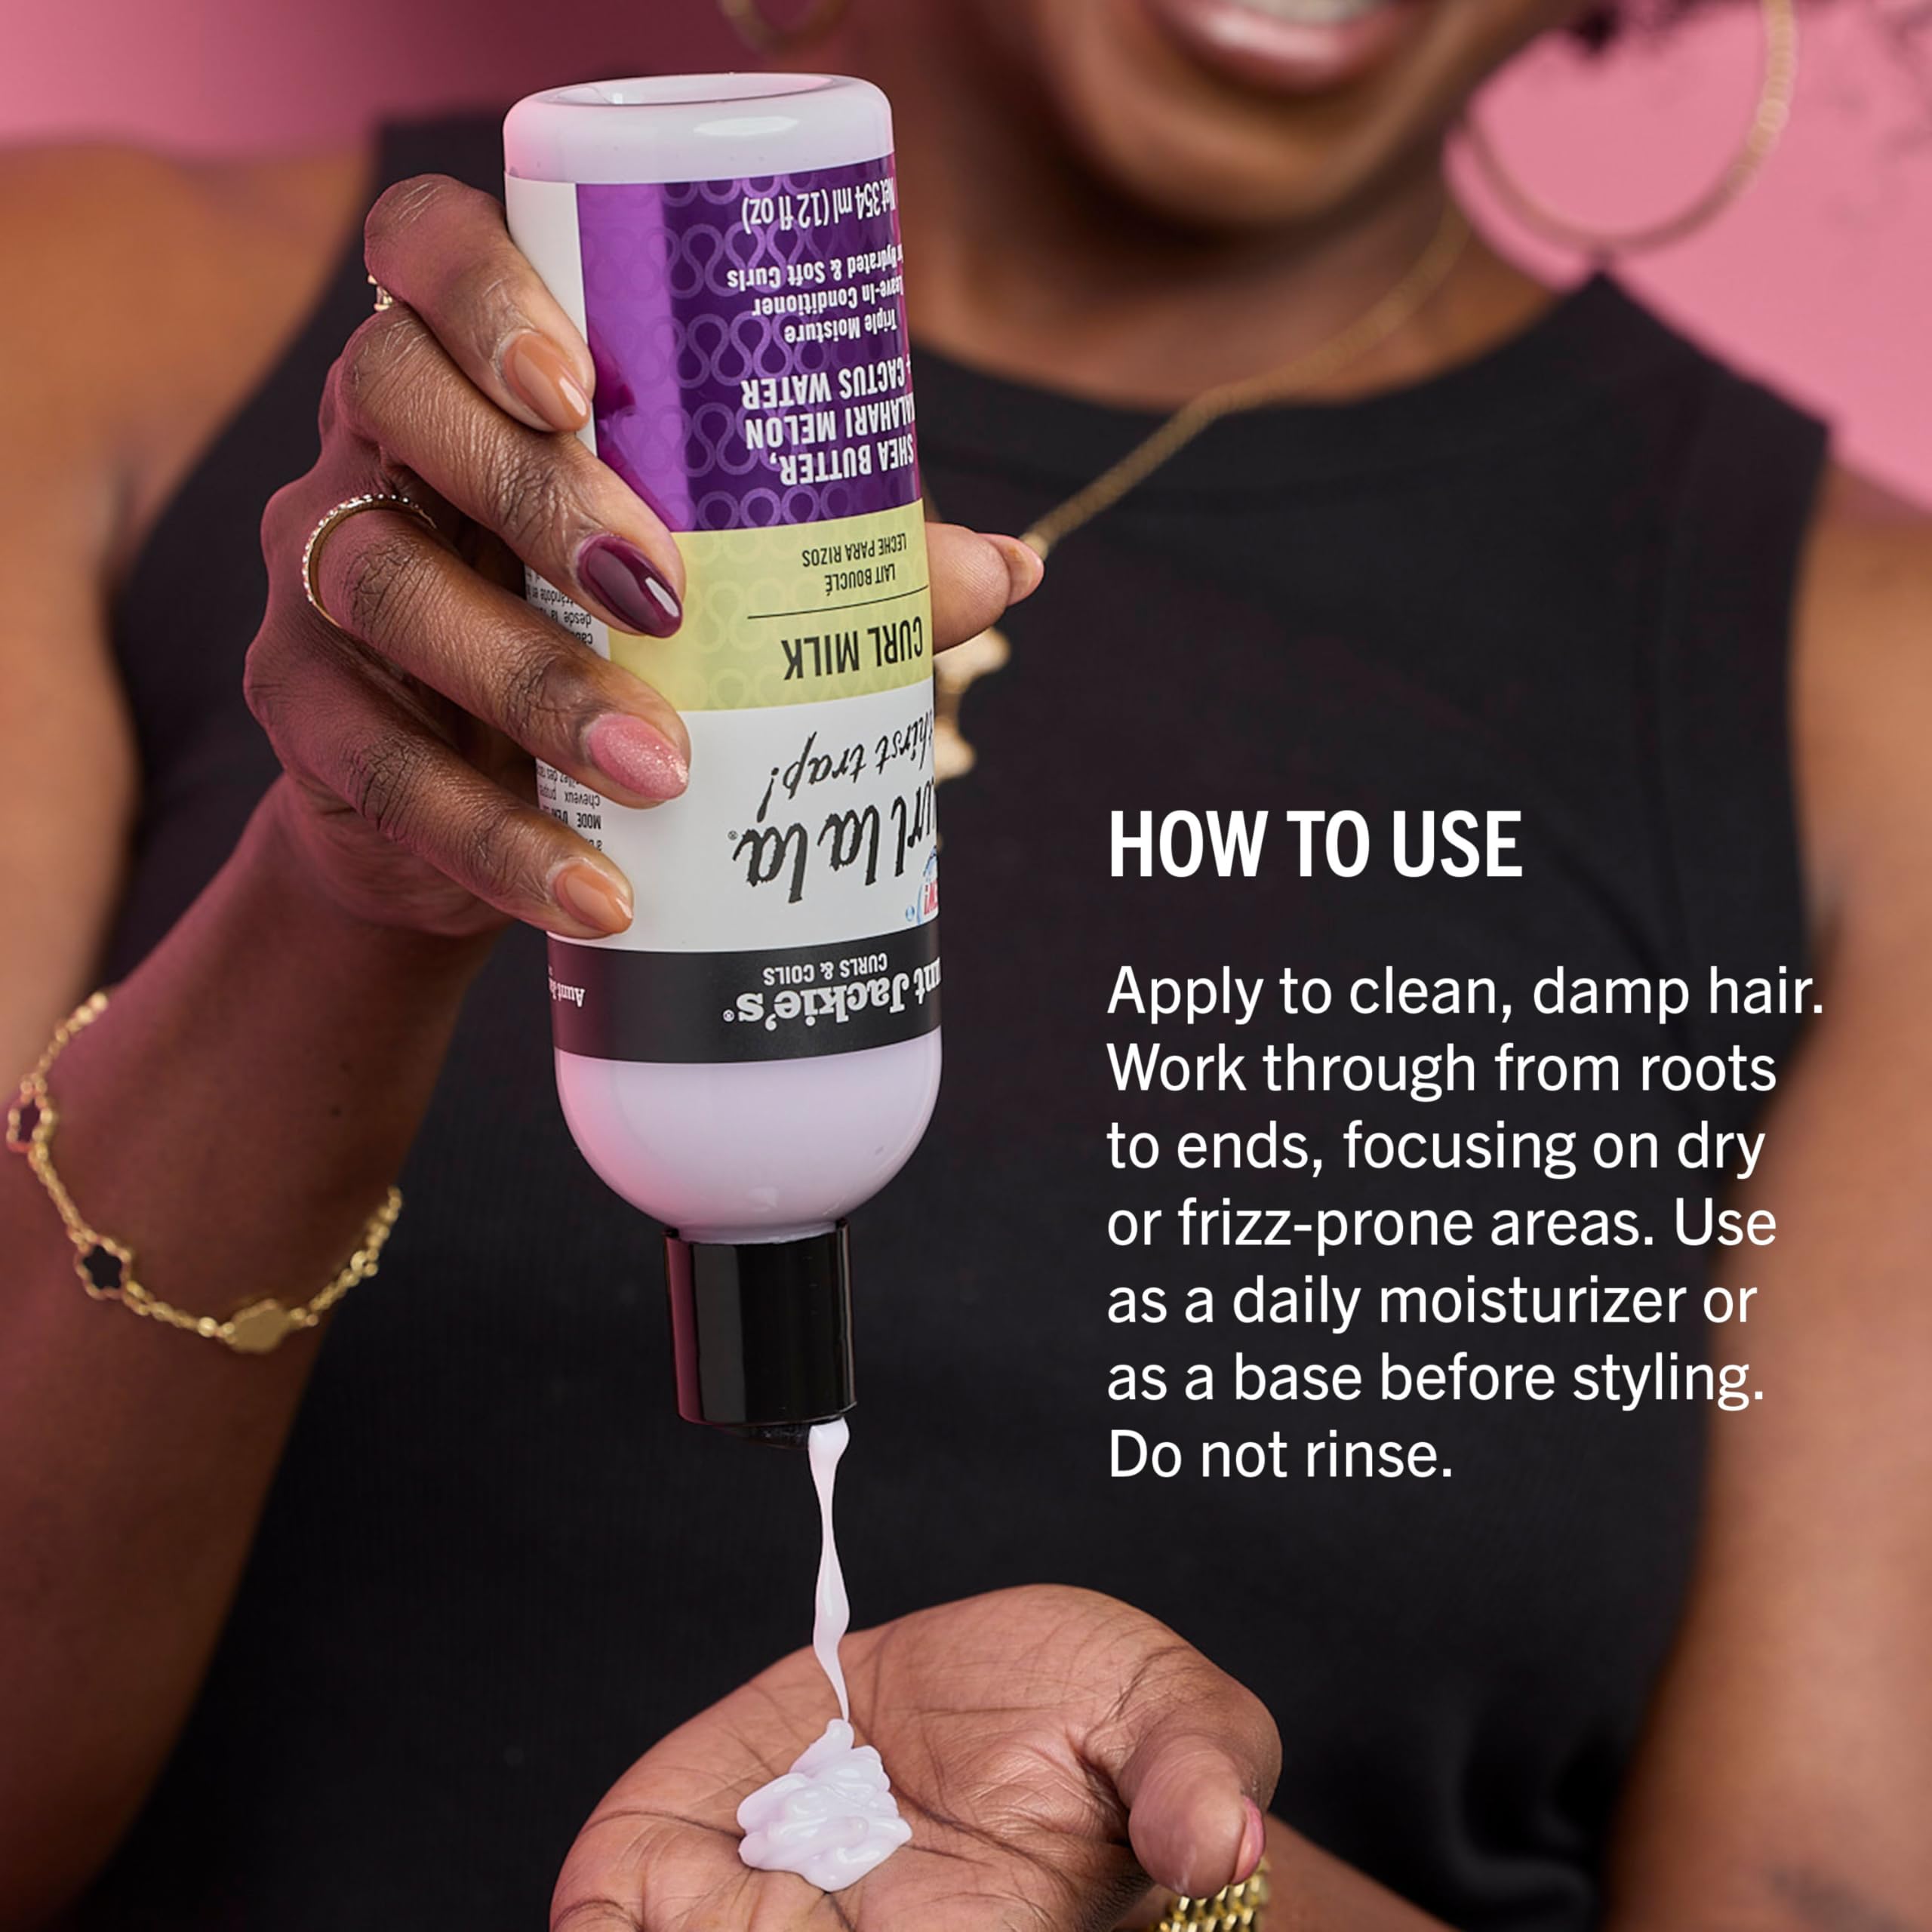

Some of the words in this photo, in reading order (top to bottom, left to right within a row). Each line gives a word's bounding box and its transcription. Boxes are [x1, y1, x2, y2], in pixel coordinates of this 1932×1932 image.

[742, 197, 774, 235] oz)
[779, 195, 793, 231] fl
[797, 189, 829, 228] (12
[832, 187, 853, 223] ml
[855, 180, 881, 220] 354
[788, 261, 825, 287] Soft
[830, 260, 841, 281] &
[848, 244, 897, 278] Hydrated
[727, 266, 781, 292] Curls
[752, 287, 858, 316] Conditioner
[784, 315, 861, 343] Moisture
[864, 309, 897, 334] Triple
[740, 372, 832, 411] WATER
[838, 356, 906, 400] CACTUS
[745, 411, 837, 450] MELON
[845, 392, 915, 438] ALAHARI
[769, 444, 872, 487] BUTTER,
[877, 433, 915, 472] SHEA
[801, 546, 842, 567] RIZOS
[844, 540, 875, 562] PARA
[878, 533, 907, 556] LECHE
[824, 568, 872, 596] BOUCLÉ
[875, 563, 896, 584] LAIT
[780, 630, 860, 681] MILK
[866, 616, 923, 667] CURL
[756, 731, 866, 823] trap!
[565, 791, 601, 809] cheveux
[577, 812, 601, 829] MODE
[817, 804, 881, 886] la
[733, 823, 808, 904] la
[762, 964, 815, 986] COILS
[820, 961, 835, 980] &
[839, 952, 888, 978] CURLS
[557, 982, 586, 1008] Aunt
[736, 973, 909, 1031] Jackie's
